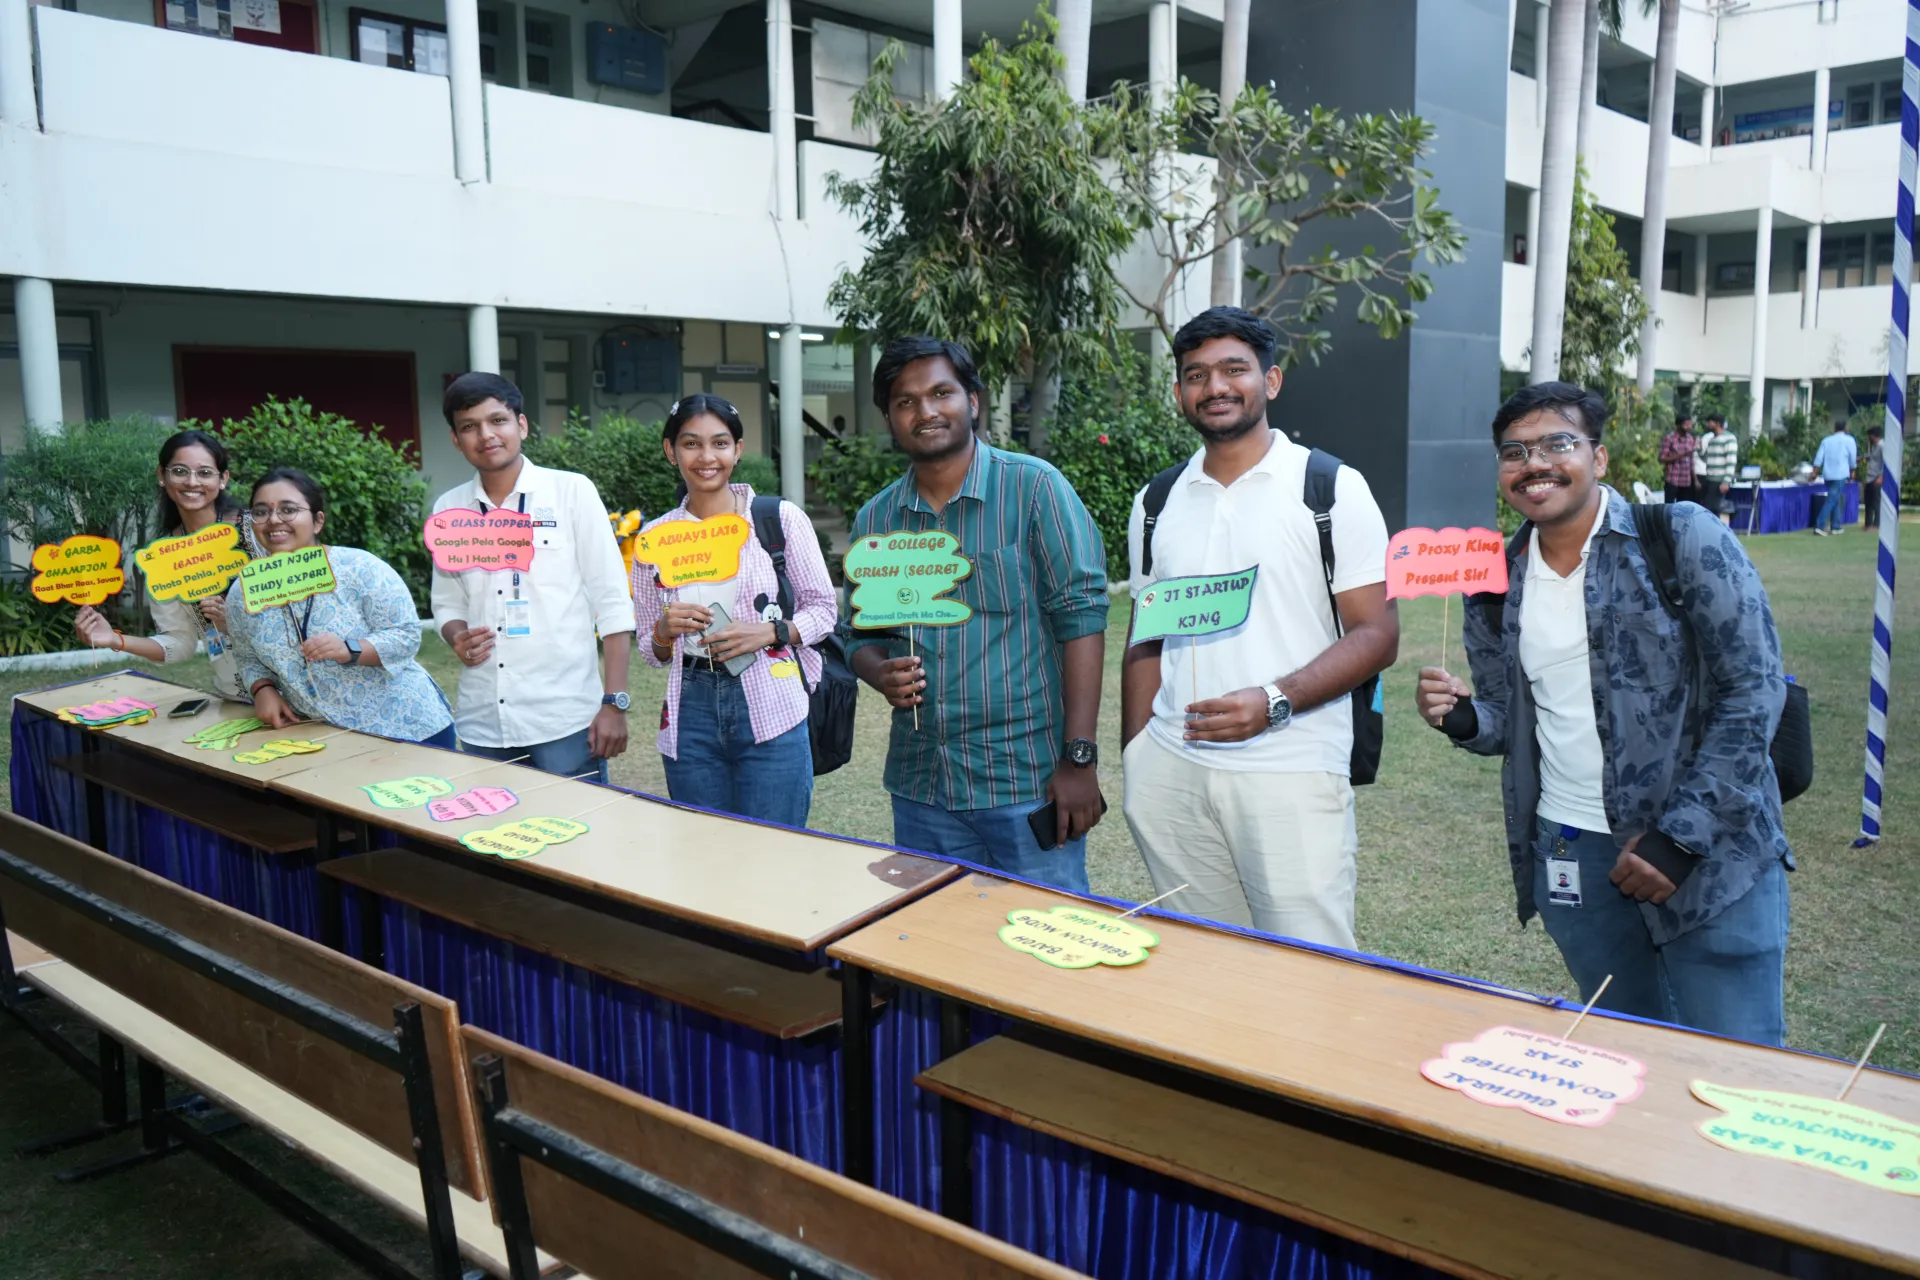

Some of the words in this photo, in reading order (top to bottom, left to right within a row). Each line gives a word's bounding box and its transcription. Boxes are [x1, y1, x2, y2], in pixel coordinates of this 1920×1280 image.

[451, 519, 485, 528] CLASS
[489, 518, 531, 528] TOPPER
[159, 539, 194, 555] SELFIE
[196, 527, 231, 545] SQUAD
[434, 538, 470, 548] Google
[472, 538, 494, 546] Pela
[497, 538, 530, 547] Google
[658, 528, 707, 547] ALWAYS
[711, 524, 739, 538] LATE
[888, 537, 946, 551] COLLEGE
[65, 544, 101, 558] GARBA
[1417, 543, 1461, 556] Proxy
[1465, 539, 1499, 554] King
[173, 552, 214, 571] LEADER
[259, 559, 283, 573] LAST
[287, 549, 322, 565] NIGHT
[448, 555, 463, 563] Hu
[473, 555, 500, 563] Hato!
[672, 552, 712, 567] ENTRY
[45, 561, 107, 578] CHAMPION
[853, 565, 900, 579] CRUSH
[904, 564, 959, 579] (SECRET
[1405, 570, 1459, 585] Present
[1463, 568, 1489, 581] Sir!
[151, 580, 182, 593] Photo
[183, 570, 216, 583] Pehla,
[187, 582, 221, 598] Kaam!
[249, 578, 283, 594] STUDY
[287, 567, 327, 584] EXPERT
[1185, 577, 1250, 599] STARTUP
[70, 591, 91, 599] Class!
[1178, 611, 1221, 629] KING
[1016, 915, 1061, 933] MODE
[1012, 935, 1063, 954] BATCH
[1060, 931, 1132, 958] REUNION
[1524, 1048, 1584, 1069] STAR
[1461, 1056, 1617, 1100] COMMITTEE
[1443, 1072, 1557, 1107] CULTURAL
[1709, 1126, 1785, 1150] FEAR
[1751, 1111, 1896, 1151] SURVIVOR
[1794, 1144, 1869, 1171] VIVA
